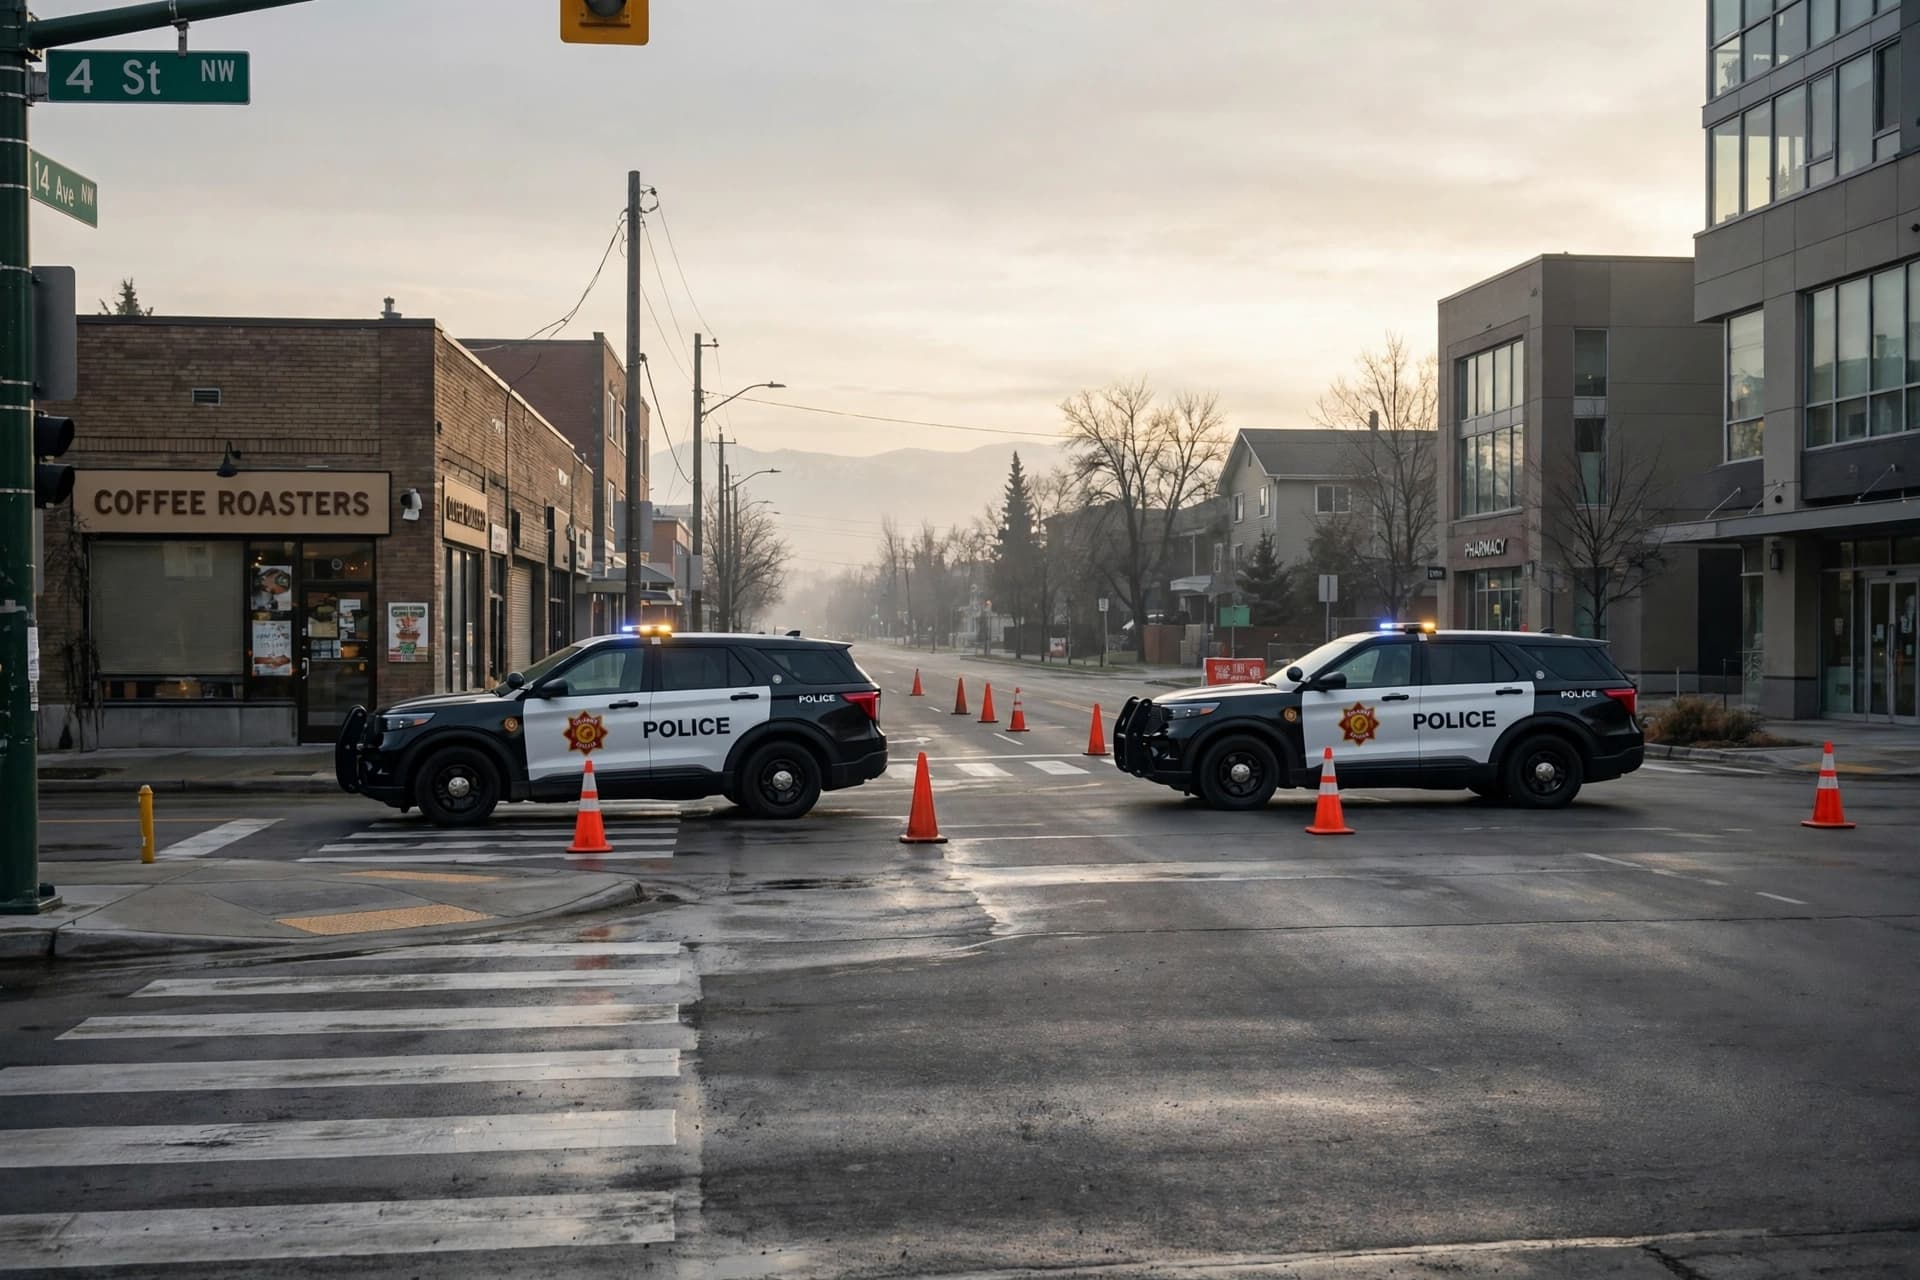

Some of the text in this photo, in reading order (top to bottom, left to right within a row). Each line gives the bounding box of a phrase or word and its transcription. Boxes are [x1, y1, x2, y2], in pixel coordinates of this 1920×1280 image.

[65, 59, 235, 95] 4 St NW
[35, 160, 94, 208] 14 Ave NW
[94, 489, 370, 517] COFFEE ROASTERS
[1464, 538, 1505, 557] PHARMACY
[799, 694, 836, 704] POLICE
[1560, 690, 1597, 699] POLICE
[643, 717, 731, 739] POLICE
[1413, 710, 1497, 730] POLICE
